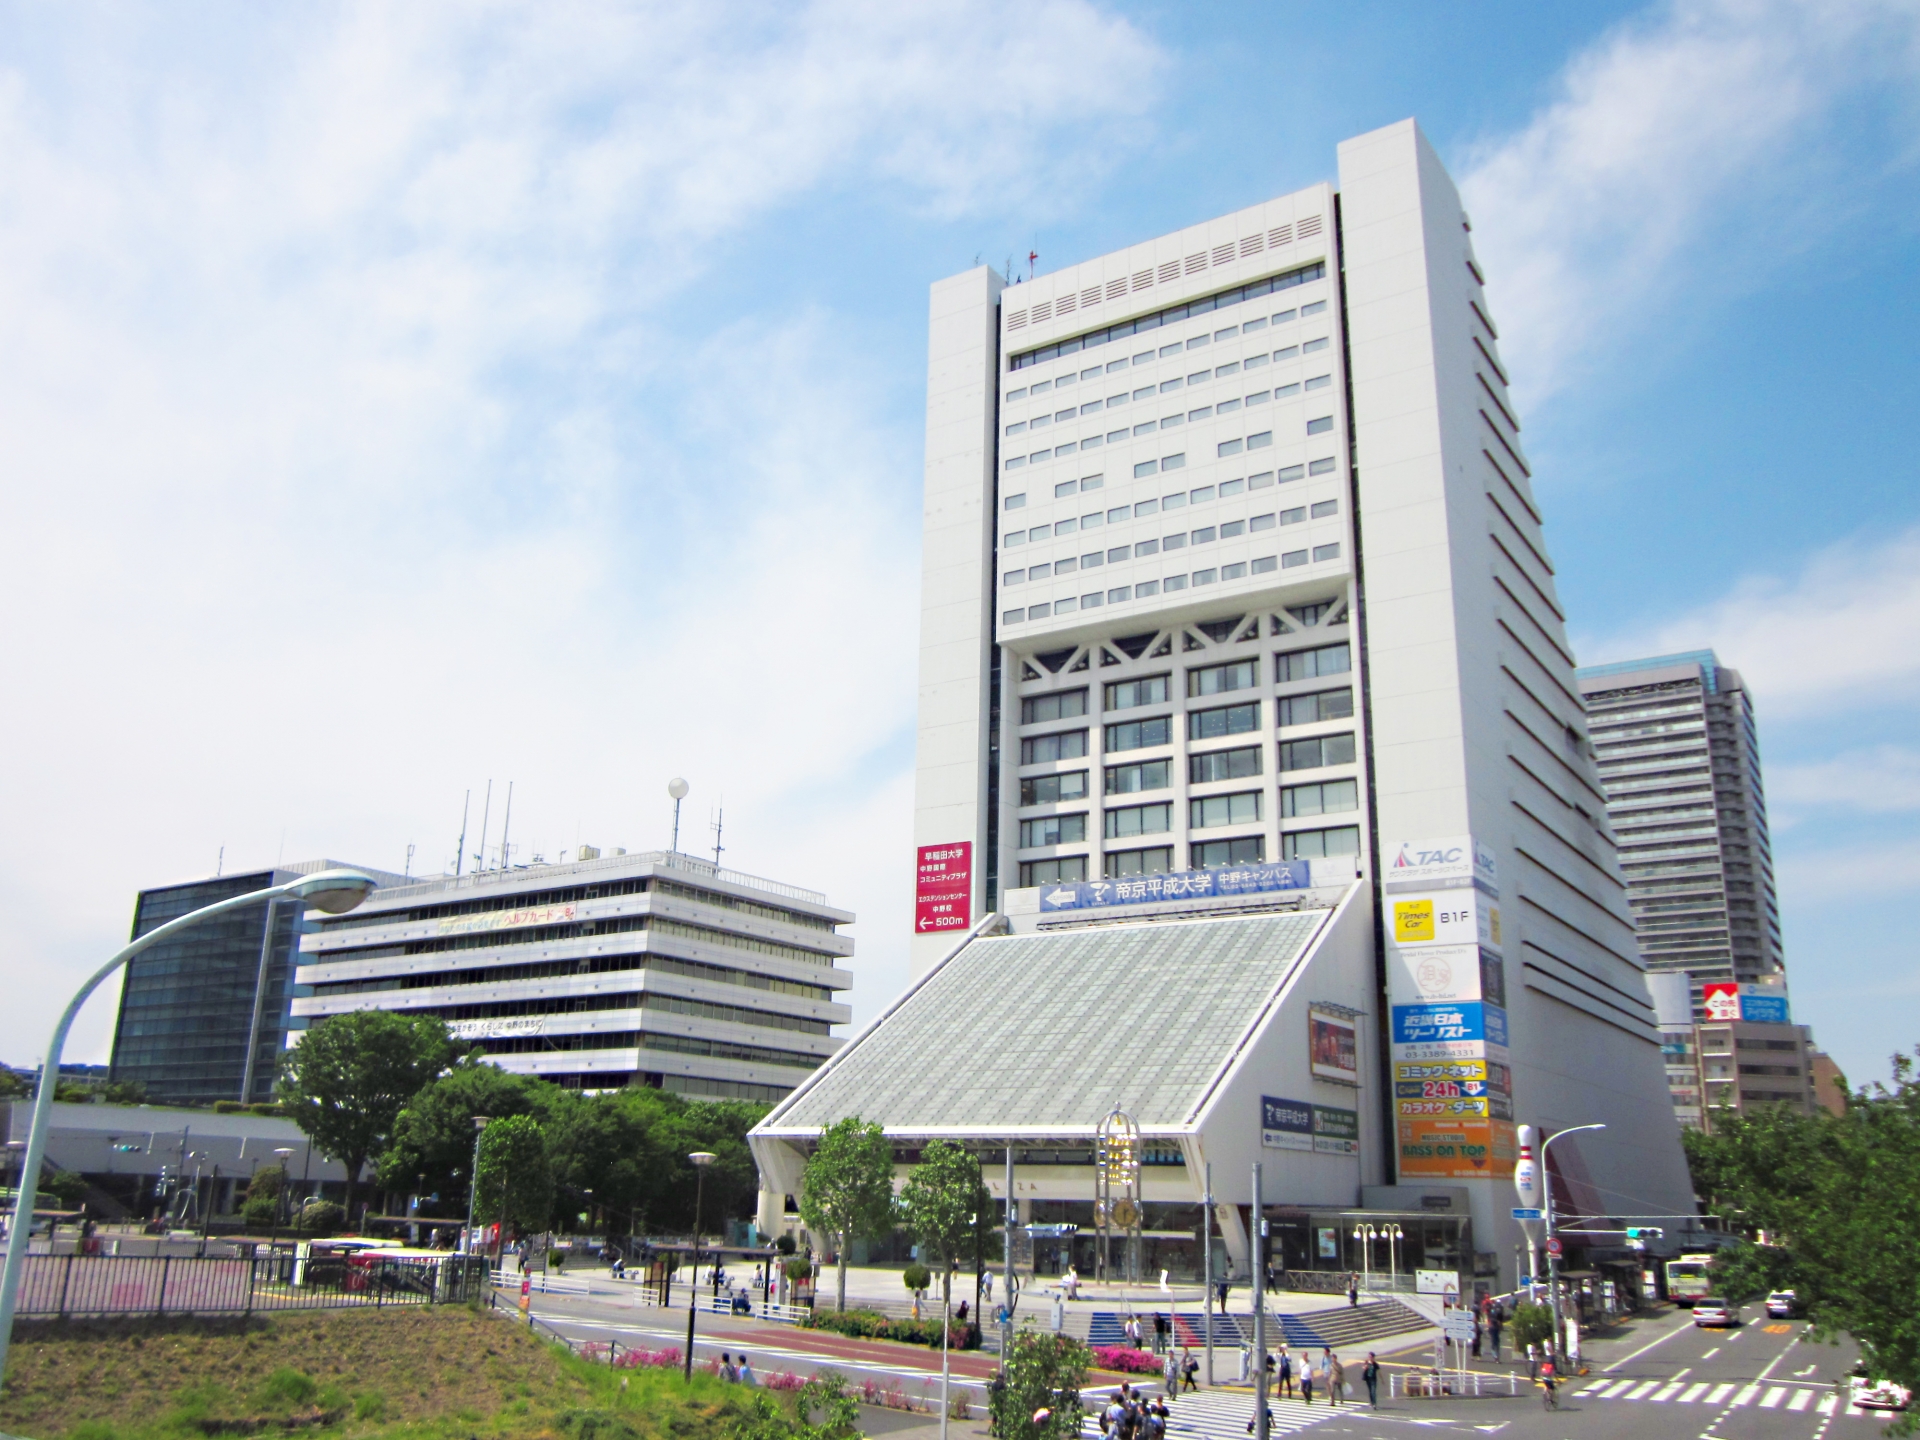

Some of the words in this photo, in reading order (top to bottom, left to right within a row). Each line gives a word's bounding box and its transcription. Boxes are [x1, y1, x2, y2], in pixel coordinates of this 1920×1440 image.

[925, 849, 963, 861] 早稲田大学
[1416, 847, 1463, 866] TAC
[920, 863, 946, 873] 中野国際
[920, 872, 967, 883] コミュニティプラザ
[1116, 874, 1212, 899] 帝京平成大学
[1219, 867, 1291, 884] 中野キャンパス
[918, 892, 967, 902] エクステンションセンター
[933, 904, 952, 913] 中野校
[504, 909, 553, 925] ヘルプカード
[936, 916, 963, 926] 500m
[1398, 912, 1430, 920] Times
[1440, 911, 1469, 923] B1F
[1405, 920, 1422, 928] Car
[1404, 1013, 1464, 1027] 近畿日本
[1404, 1026, 1472, 1040] ツーリスト
[1405, 1050, 1474, 1059] 03-3389-4331
[1400, 1064, 1482, 1078] コミック・ネット
[1423, 1081, 1460, 1098] 24h
[1402, 1101, 1485, 1114] カラオケ・ダーツ
[1459, 1145, 1486, 1156] TOP
